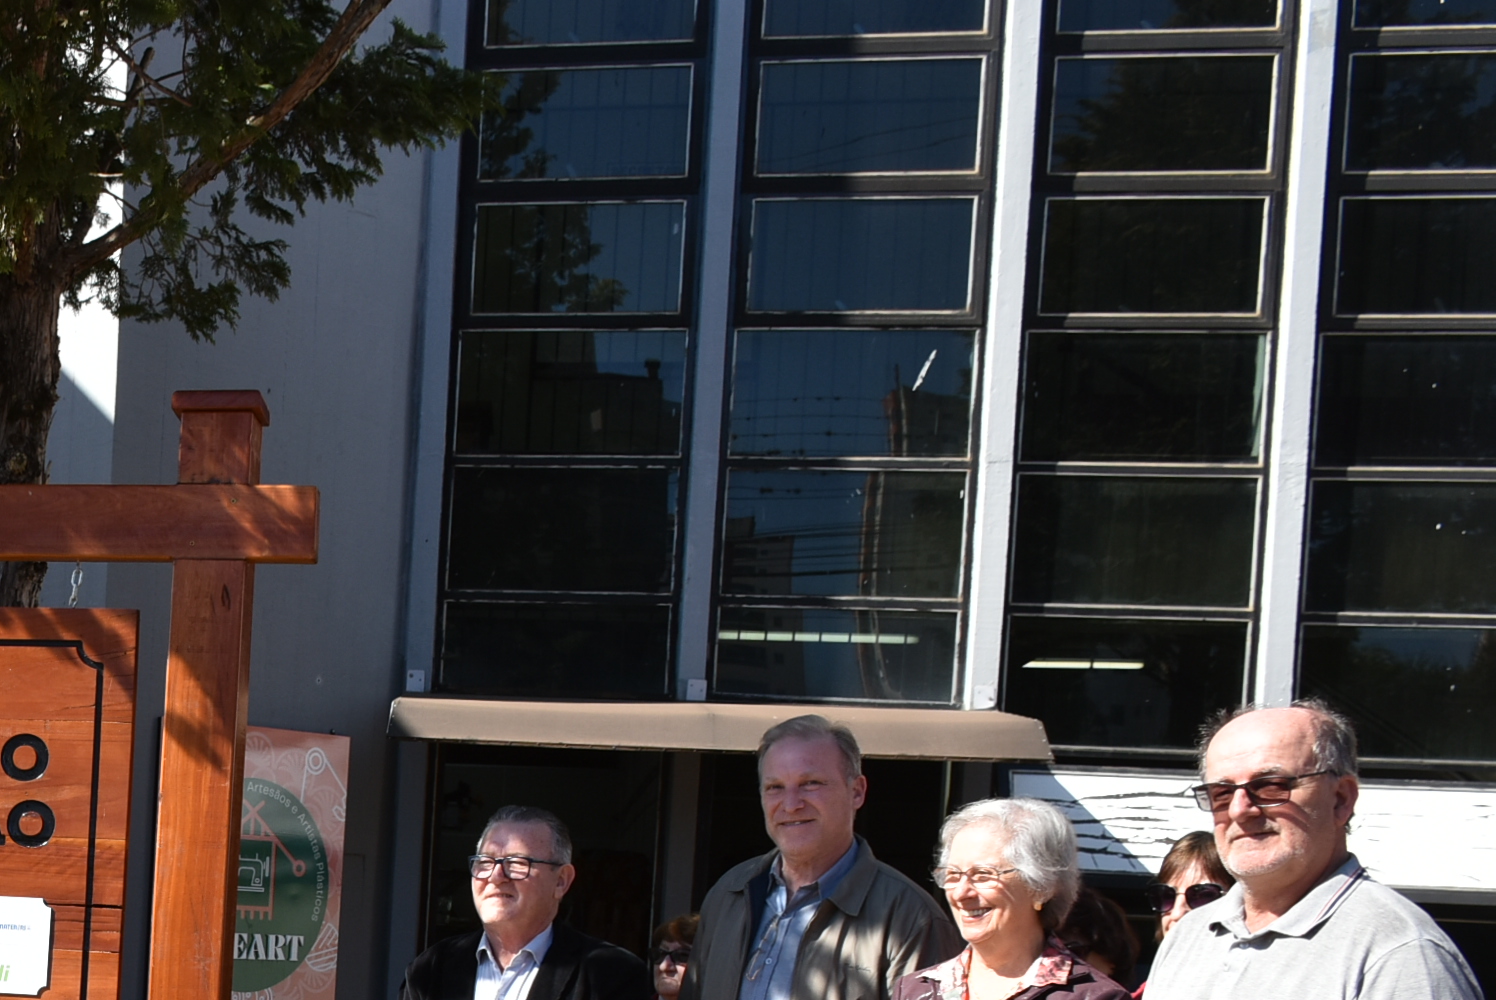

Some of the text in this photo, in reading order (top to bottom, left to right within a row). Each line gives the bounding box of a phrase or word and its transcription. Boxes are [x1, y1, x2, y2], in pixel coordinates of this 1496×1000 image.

[247, 781, 325, 922] Artesãos e Artistas Plásticos
